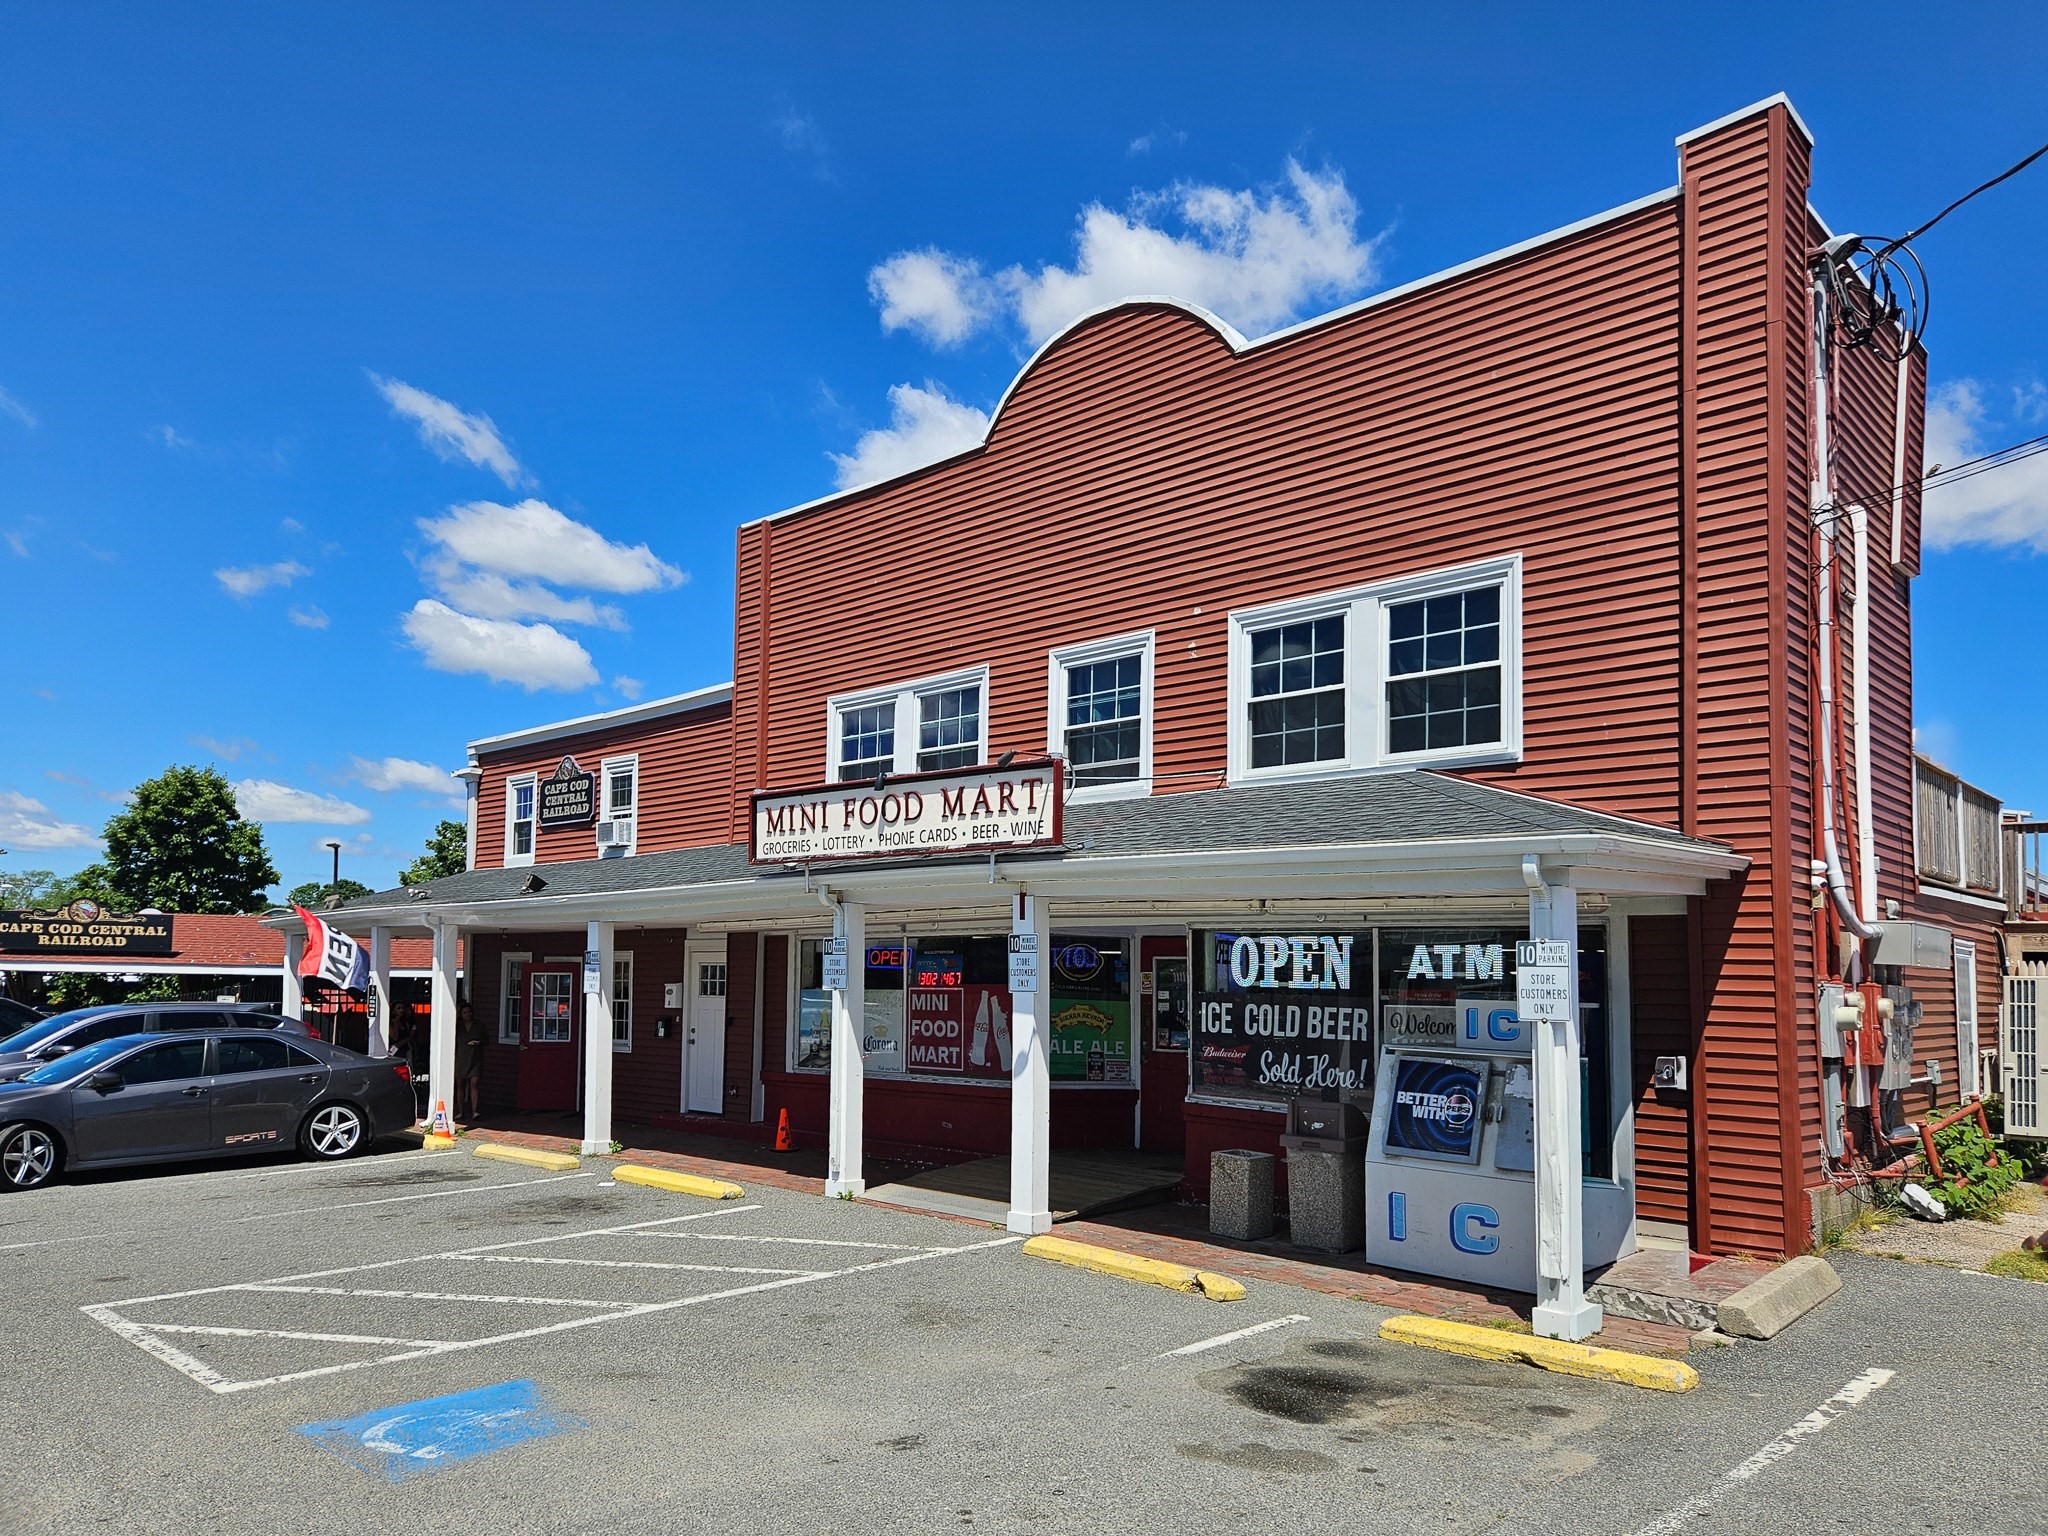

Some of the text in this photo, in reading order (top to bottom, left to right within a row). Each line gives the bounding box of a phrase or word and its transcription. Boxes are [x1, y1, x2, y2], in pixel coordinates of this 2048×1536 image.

[544, 780, 589, 795] CAPE COD
[545, 792, 587, 806] CENTRAL
[765, 777, 1043, 834] MINI FOOD MART
[543, 803, 589, 818] RAILROAD
[763, 820, 1044, 855] GROCERIES LOTTERY PHONE CARDS BEER WINE
[0, 923, 167, 936] CAPE COD CENTRAL
[38, 935, 127, 946] RAILROAD
[825, 941, 833, 953] 10
[1010, 938, 1019, 951] 10
[1519, 945, 1535, 964] 10
[1541, 946, 1564, 954] MINUTE
[870, 951, 909, 965] OPEN
[1016, 958, 1030, 966] STORE
[1231, 936, 1353, 989] OPEN
[1407, 944, 1503, 979] ATM
[1538, 955, 1567, 964] PARKING
[1018, 979, 1029, 987] ONLY
[1531, 974, 1556, 985] STORE
[1521, 989, 1567, 1000] CUSTOMERS
[911, 994, 948, 1011] MINI
[1534, 1004, 1555, 1014] ONLY
[1059, 1012, 1105, 1023] SIERRA NEVADA
[1201, 1002, 1233, 1034] ICE
[1244, 1003, 1301, 1038] COLD
[1306, 1006, 1369, 1041] BEER
[1390, 1012, 1456, 1036] Welcom
[911, 1020, 959, 1038] FOOD
[863, 1035, 898, 1052] Corona
[1050, 1039, 1125, 1055] ALE ALE
[911, 1045, 960, 1064] MART
[1202, 1046, 1246, 1058] Budweiser
[1260, 1050, 1303, 1084] Sold
[1304, 1054, 1368, 1089] Here!
[1396, 1091, 1447, 1107] BETTER
[1412, 1105, 1446, 1120] WITH
[1446, 1105, 1471, 1113] PEPSI
[225, 1130, 277, 1144] SPORTS
